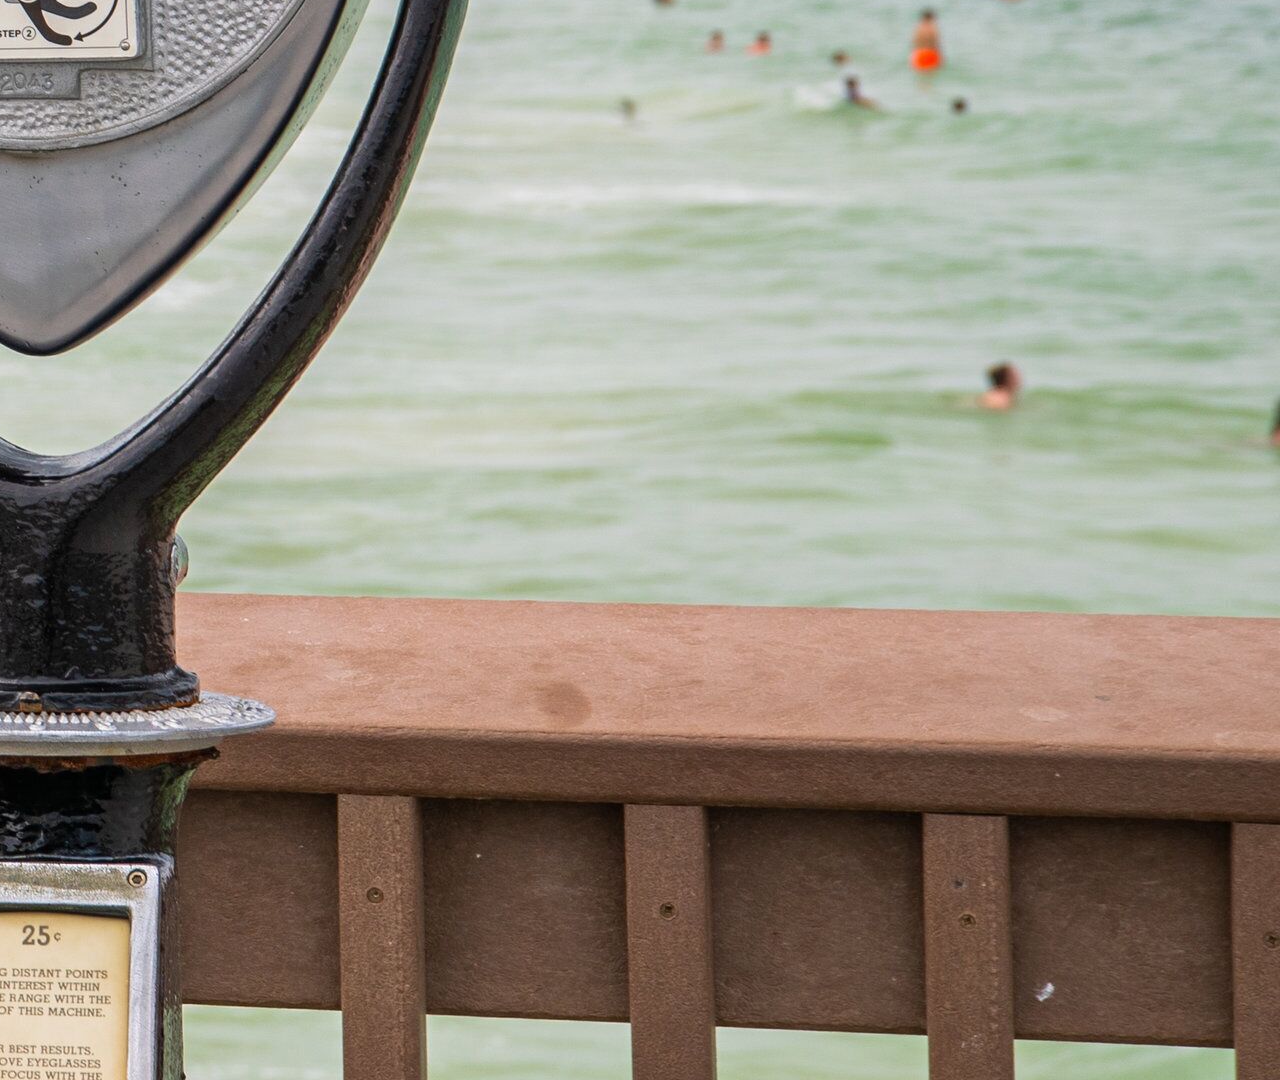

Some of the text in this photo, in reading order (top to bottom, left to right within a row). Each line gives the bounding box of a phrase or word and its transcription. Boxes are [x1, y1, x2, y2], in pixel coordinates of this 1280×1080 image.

[12, 968, 61, 978] DISTANT
[65, 969, 108, 979] POINTS
[0, 980, 53, 990] INTEREST
[58, 982, 100, 991] WITHIN
[9, 994, 50, 1003] RANGE
[54, 995, 84, 1004] WITH
[89, 995, 111, 1004] THE
[19, 1006, 44, 1015] THIS
[48, 1007, 106, 1017] MACHINE.
[9, 1044, 36, 1054] BEST
[27, 1058, 101, 1068] EYEGLASSES
[1, 1070, 40, 1080] FOCUS
[45, 1071, 75, 1080] WITH
[80, 1072, 102, 1080] THE
